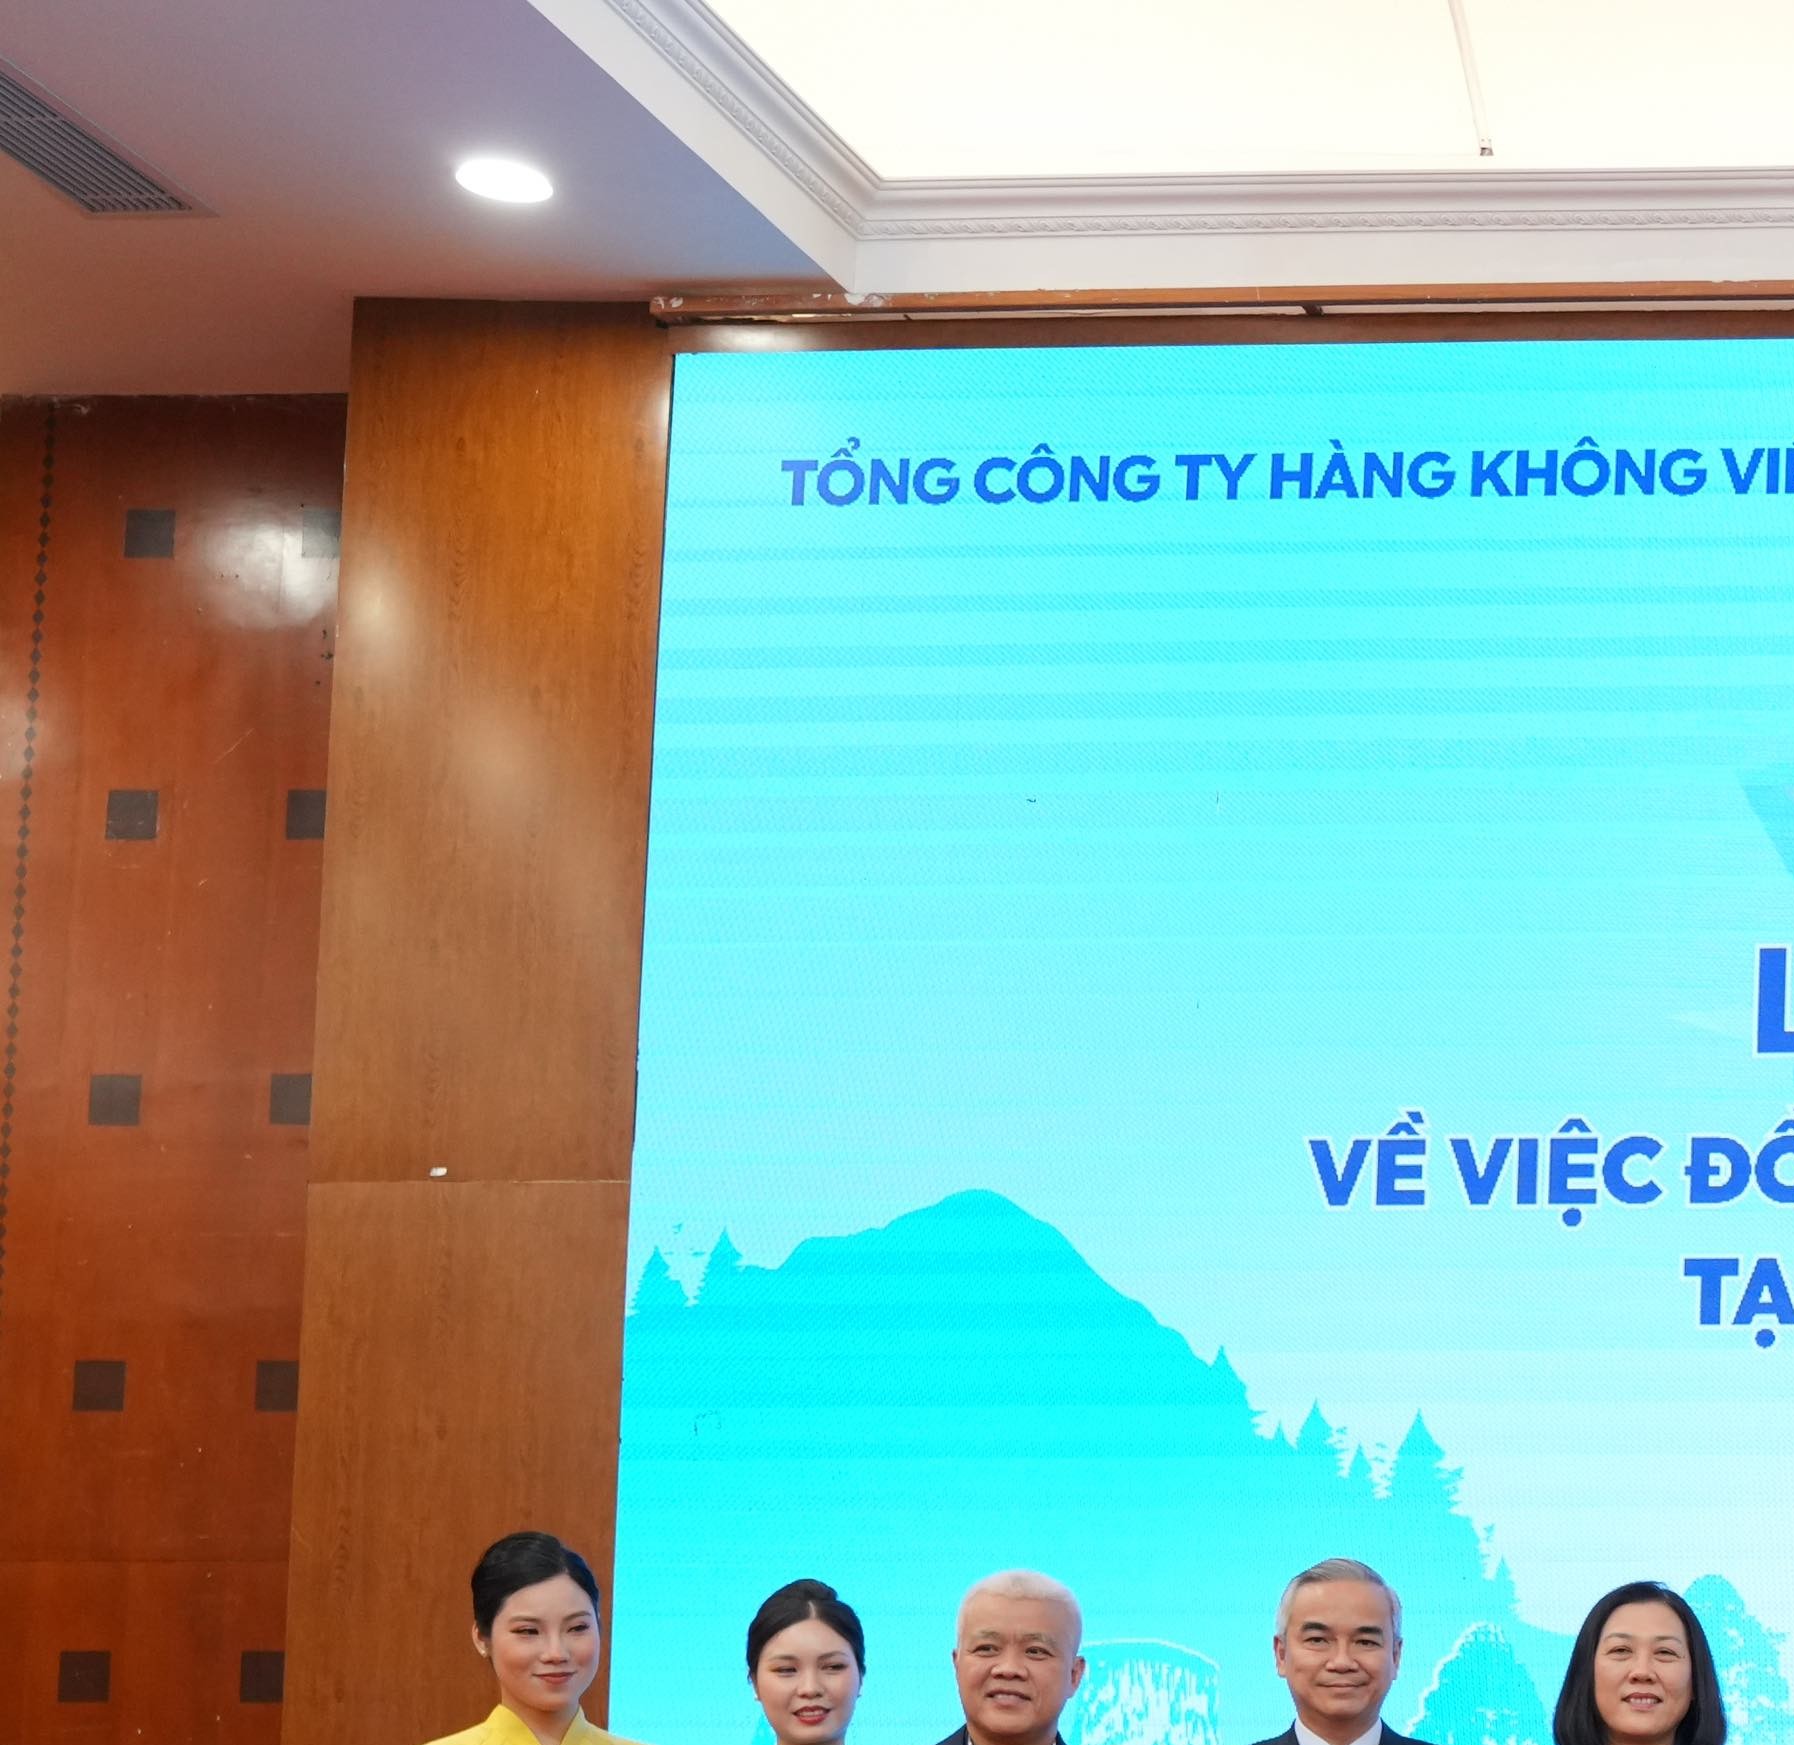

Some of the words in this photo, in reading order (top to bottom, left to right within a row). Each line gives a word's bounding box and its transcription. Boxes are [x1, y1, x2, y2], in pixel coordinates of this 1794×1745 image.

[781, 437, 959, 507] TỔNG
[974, 442, 1159, 503] CÔNG
[1176, 453, 1257, 500] TY
[1270, 438, 1456, 500] HÀNG
[1471, 435, 1704, 497] KHÔNG
[1308, 1109, 1427, 1207] VỀ
[1449, 1118, 1664, 1227] VIỆC
